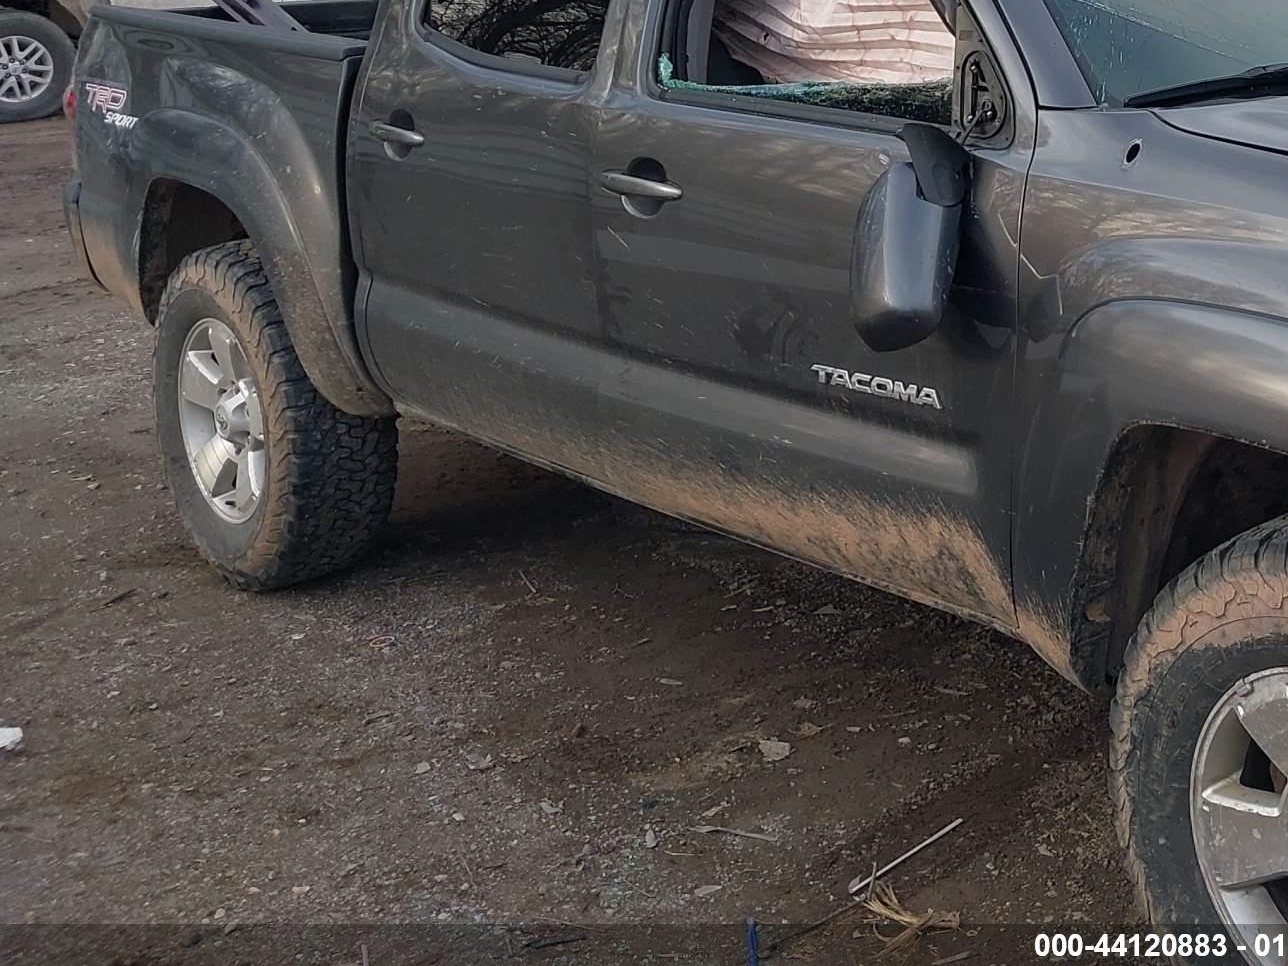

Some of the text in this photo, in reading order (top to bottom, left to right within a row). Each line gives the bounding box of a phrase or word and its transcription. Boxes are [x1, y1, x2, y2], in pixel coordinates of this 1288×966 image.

[86, 83, 127, 114] TRD
[104, 111, 139, 129] SPORT
[810, 363, 943, 410] TACOMA
